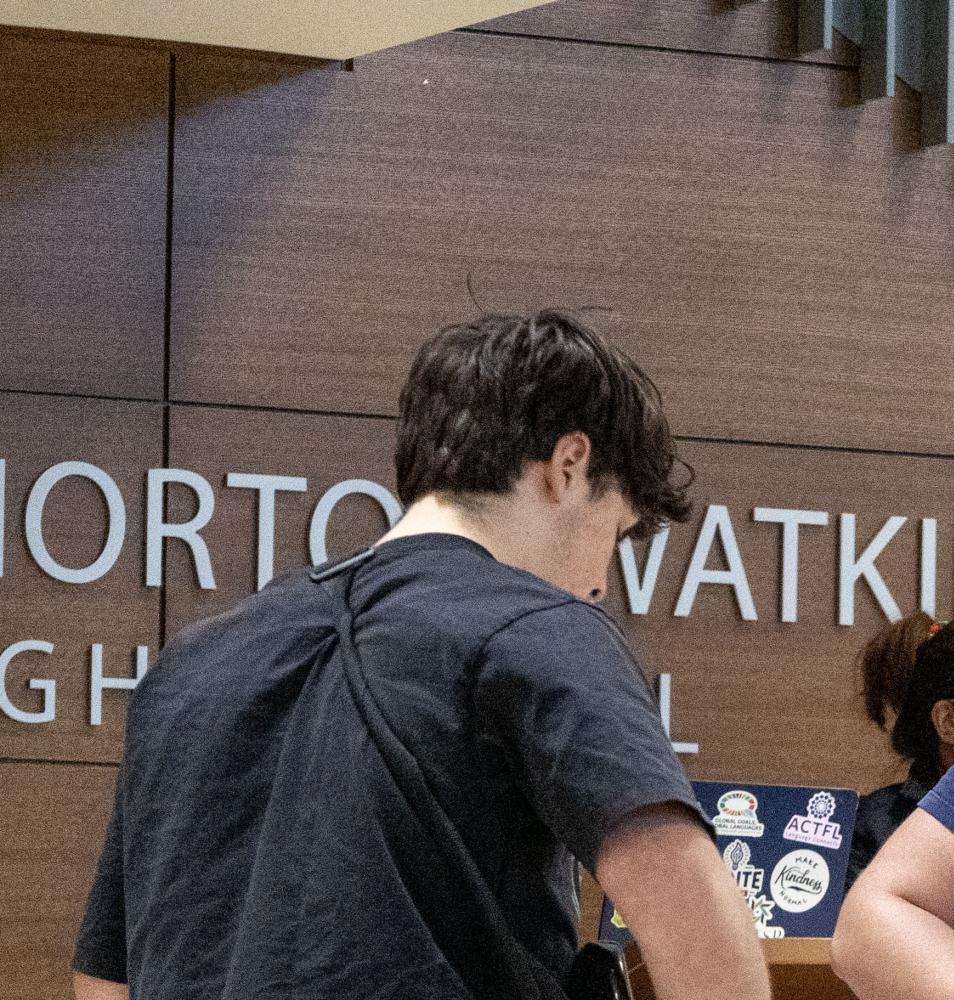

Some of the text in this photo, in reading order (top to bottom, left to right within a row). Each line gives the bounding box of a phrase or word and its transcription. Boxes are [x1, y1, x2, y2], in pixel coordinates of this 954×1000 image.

[0, 459, 402, 592] ORTO
[787, 817, 840, 841] ACTFL
[794, 856, 819, 869] MAKE
[774, 865, 823, 895] Kindness
